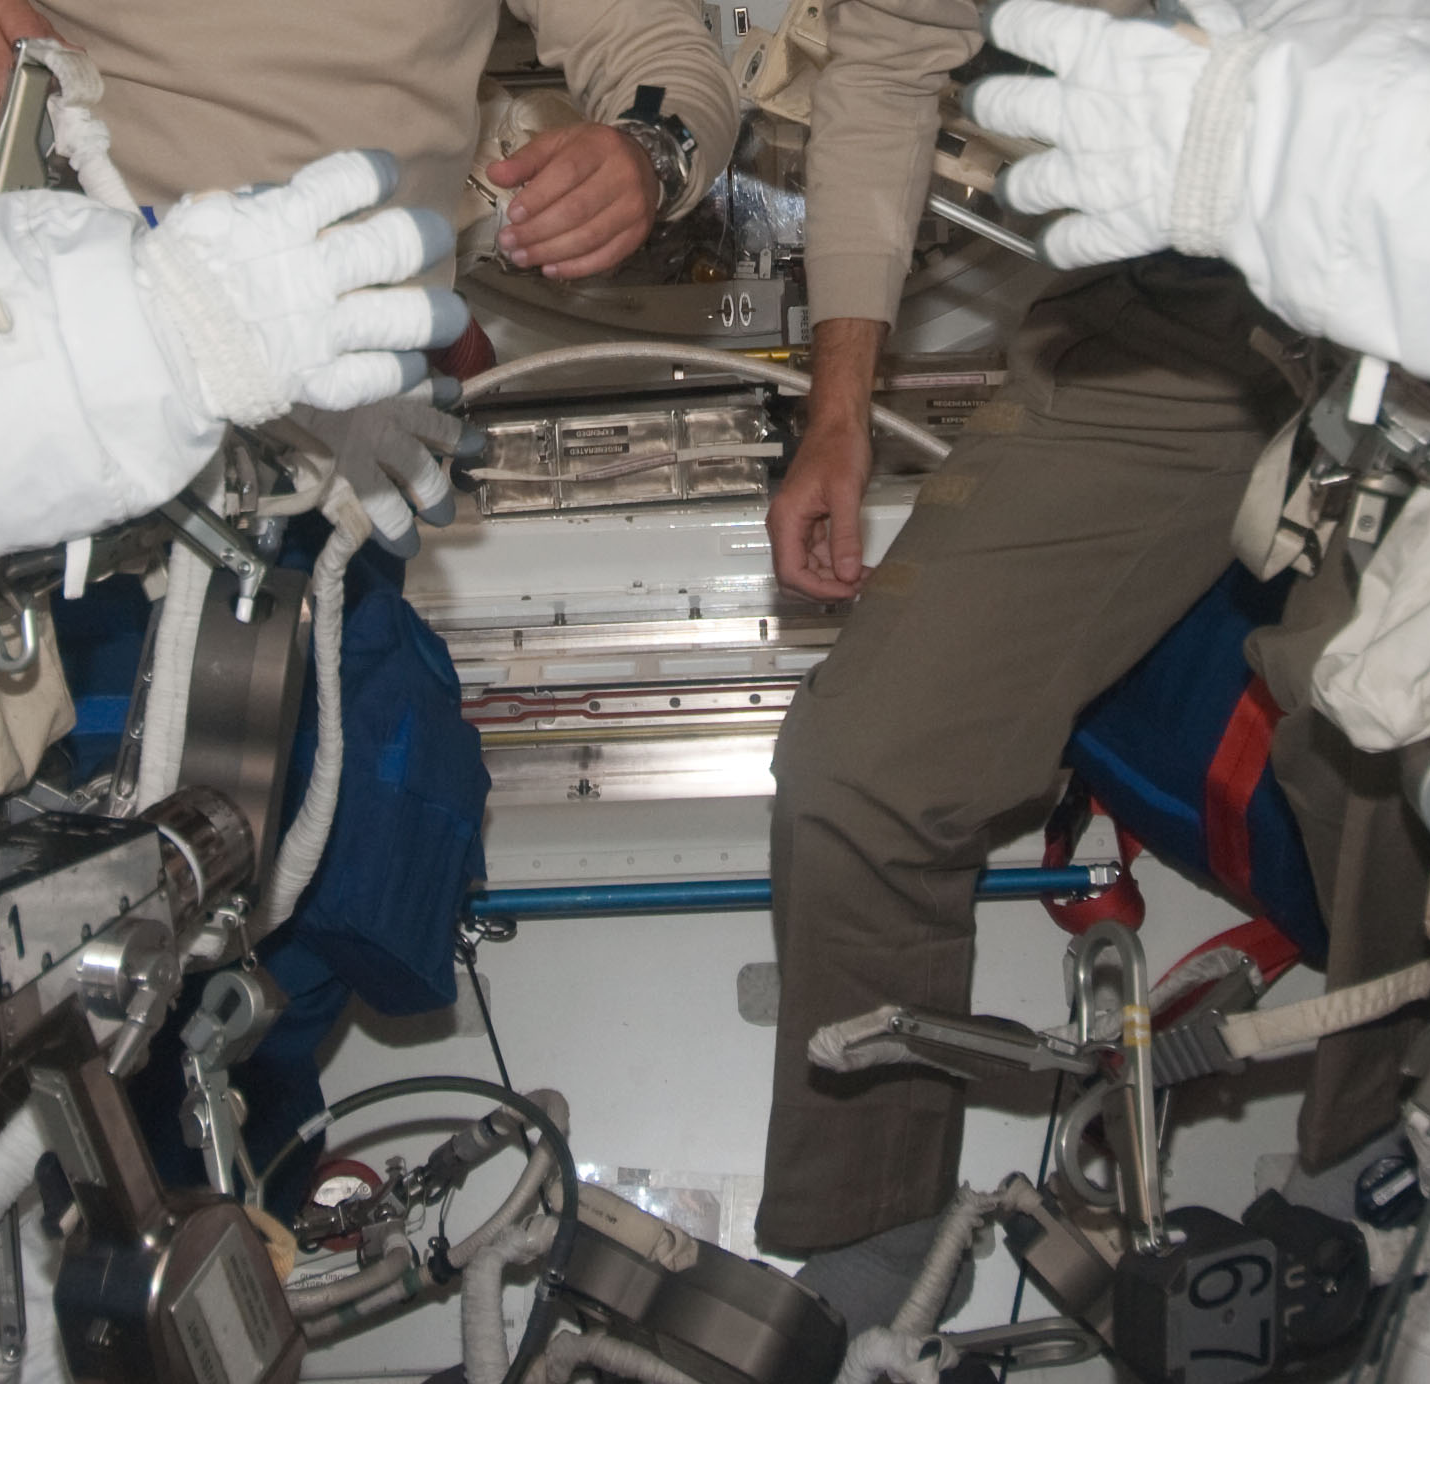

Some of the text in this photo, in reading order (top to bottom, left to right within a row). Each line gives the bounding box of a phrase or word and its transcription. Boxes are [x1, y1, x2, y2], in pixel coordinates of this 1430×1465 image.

[941, 417, 966, 425] EXPEN
[575, 428, 615, 438] EXPENDED
[569, 444, 624, 456] REGENERATED
[7, 903, 26, 961] 1
